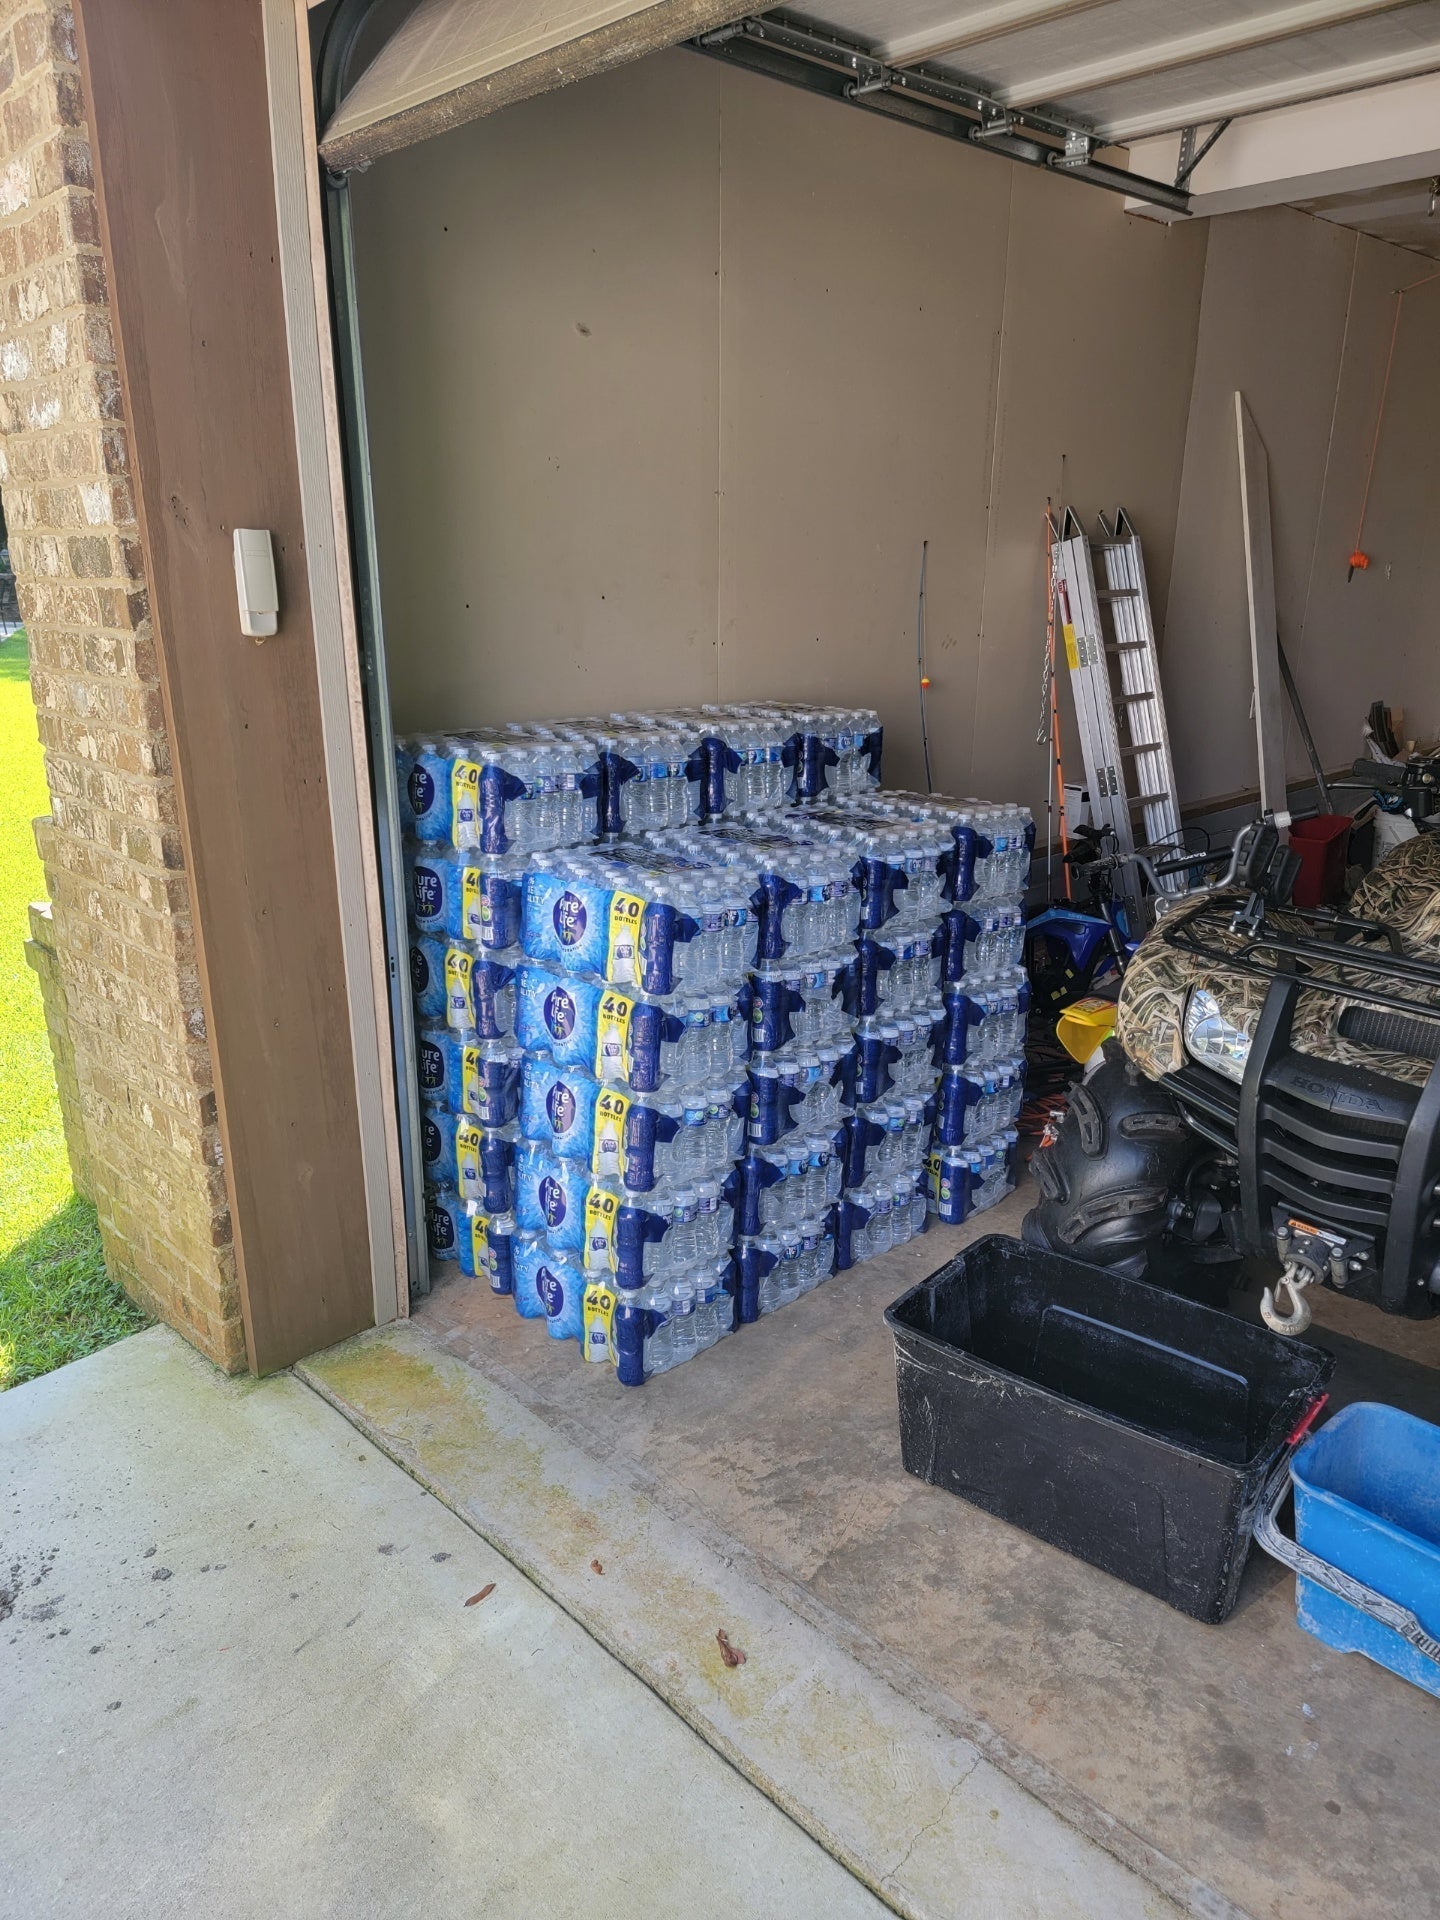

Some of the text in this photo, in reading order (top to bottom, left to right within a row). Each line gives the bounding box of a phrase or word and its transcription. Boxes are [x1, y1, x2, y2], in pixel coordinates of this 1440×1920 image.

[455, 765, 478, 784] 40
[417, 876, 437, 887] ure
[614, 897, 640, 918] 40
[614, 915, 637, 925] BOTTLES
[447, 953, 468, 973] 40
[602, 996, 628, 1018] 40
[602, 1013, 625, 1024] BOTTLES
[422, 1049, 440, 1061] ure
[1290, 1076, 1384, 1112] HONDA
[600, 1094, 624, 1115] 40
[600, 1110, 622, 1122] BOTTLES
[589, 1193, 614, 1214] 40
[589, 1209, 611, 1221] BOTTLES
[586, 1290, 611, 1311] 40
[587, 1306, 609, 1317] BOTTLES
